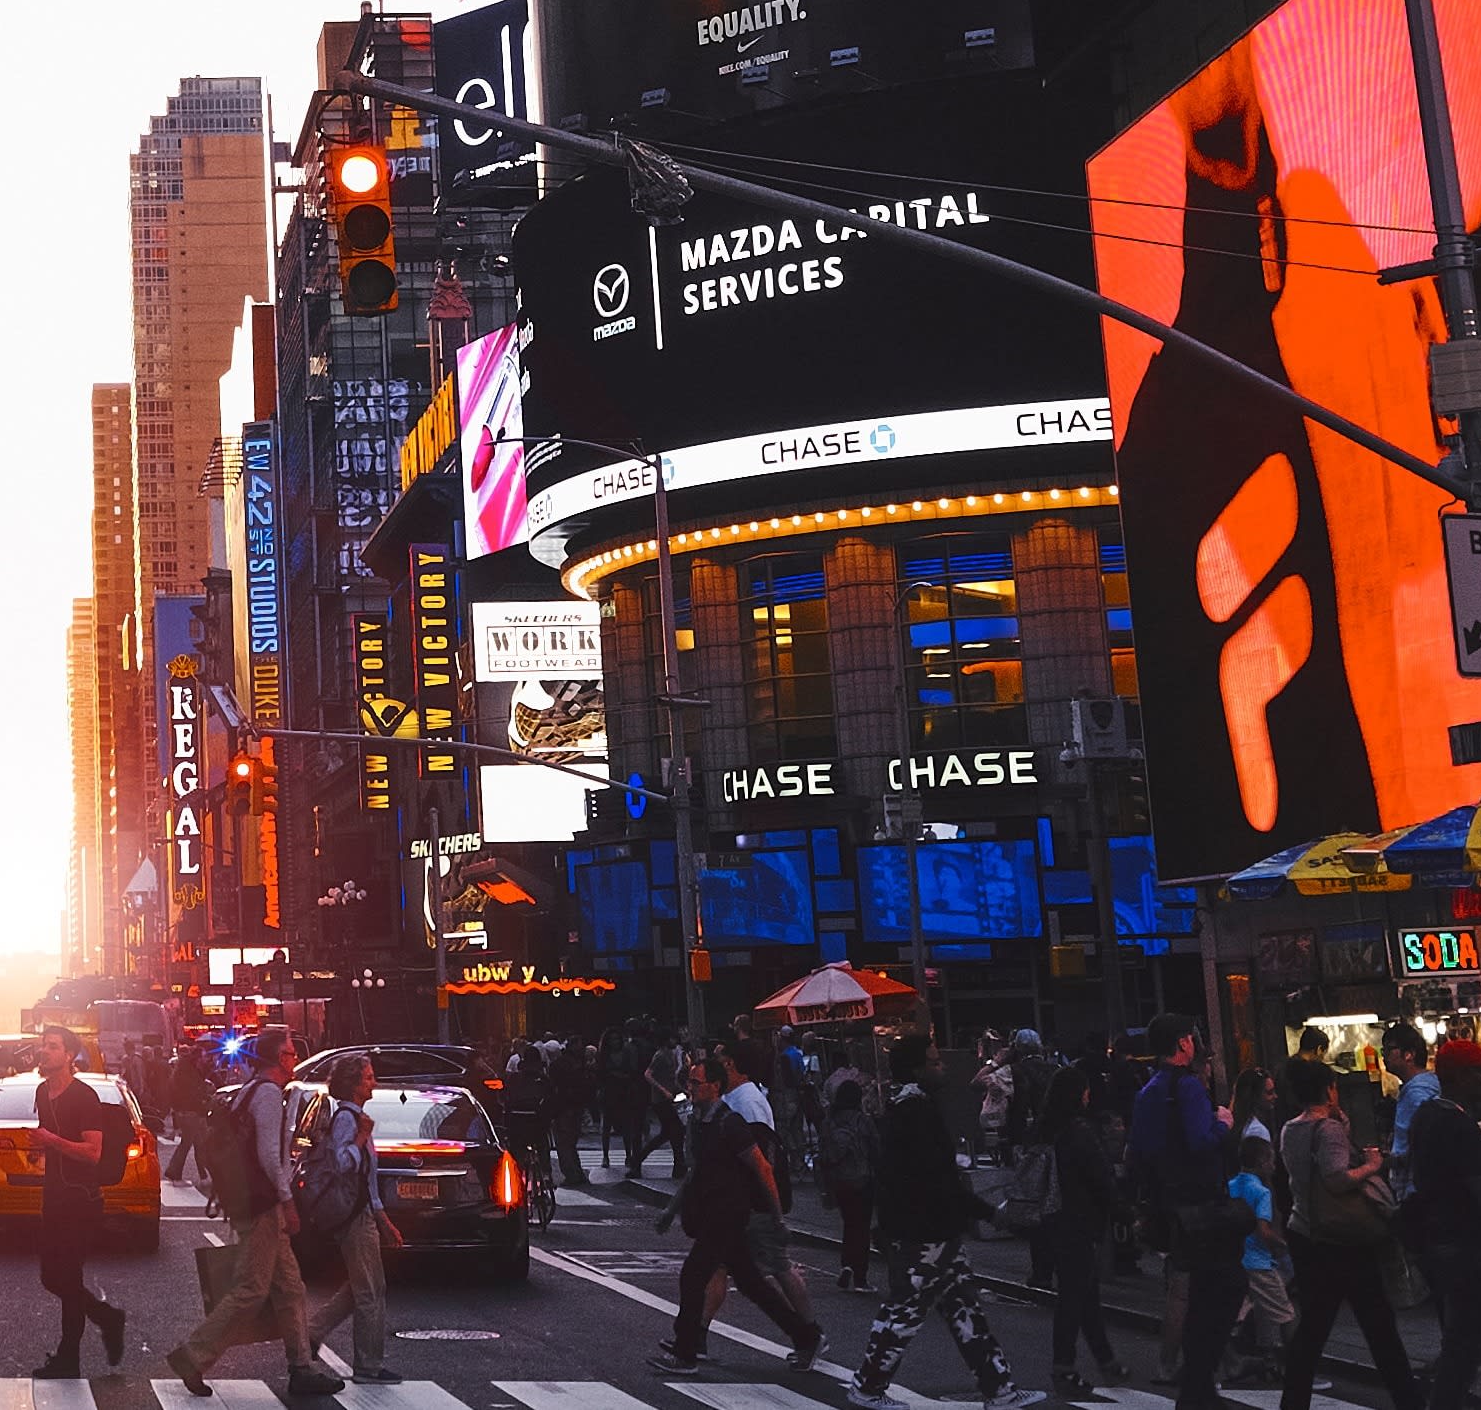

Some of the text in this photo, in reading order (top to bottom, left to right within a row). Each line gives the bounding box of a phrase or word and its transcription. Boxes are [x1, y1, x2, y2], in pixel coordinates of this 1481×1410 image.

[680, 219, 802, 272] MAZDA
[681, 256, 846, 317] SERVICES
[592, 315, 636, 342] mazda
[760, 431, 862, 465] CHASE
[248, 473, 274, 526] 42
[593, 468, 654, 499] CHASE
[249, 558, 278, 654] STUDIOS
[417, 551, 450, 688] VICTORY
[490, 629, 599, 653] WORK
[494, 657, 598, 668] FOOTWEAR
[253, 664, 280, 720] DUKE
[170, 685, 201, 875] REGAL
[366, 751, 390, 810] NEW
[723, 763, 835, 803] CHASE
[888, 750, 1038, 791] CHASE
[409, 831, 482, 859] SKCHERS
[1404, 932, 1479, 970] SODA
